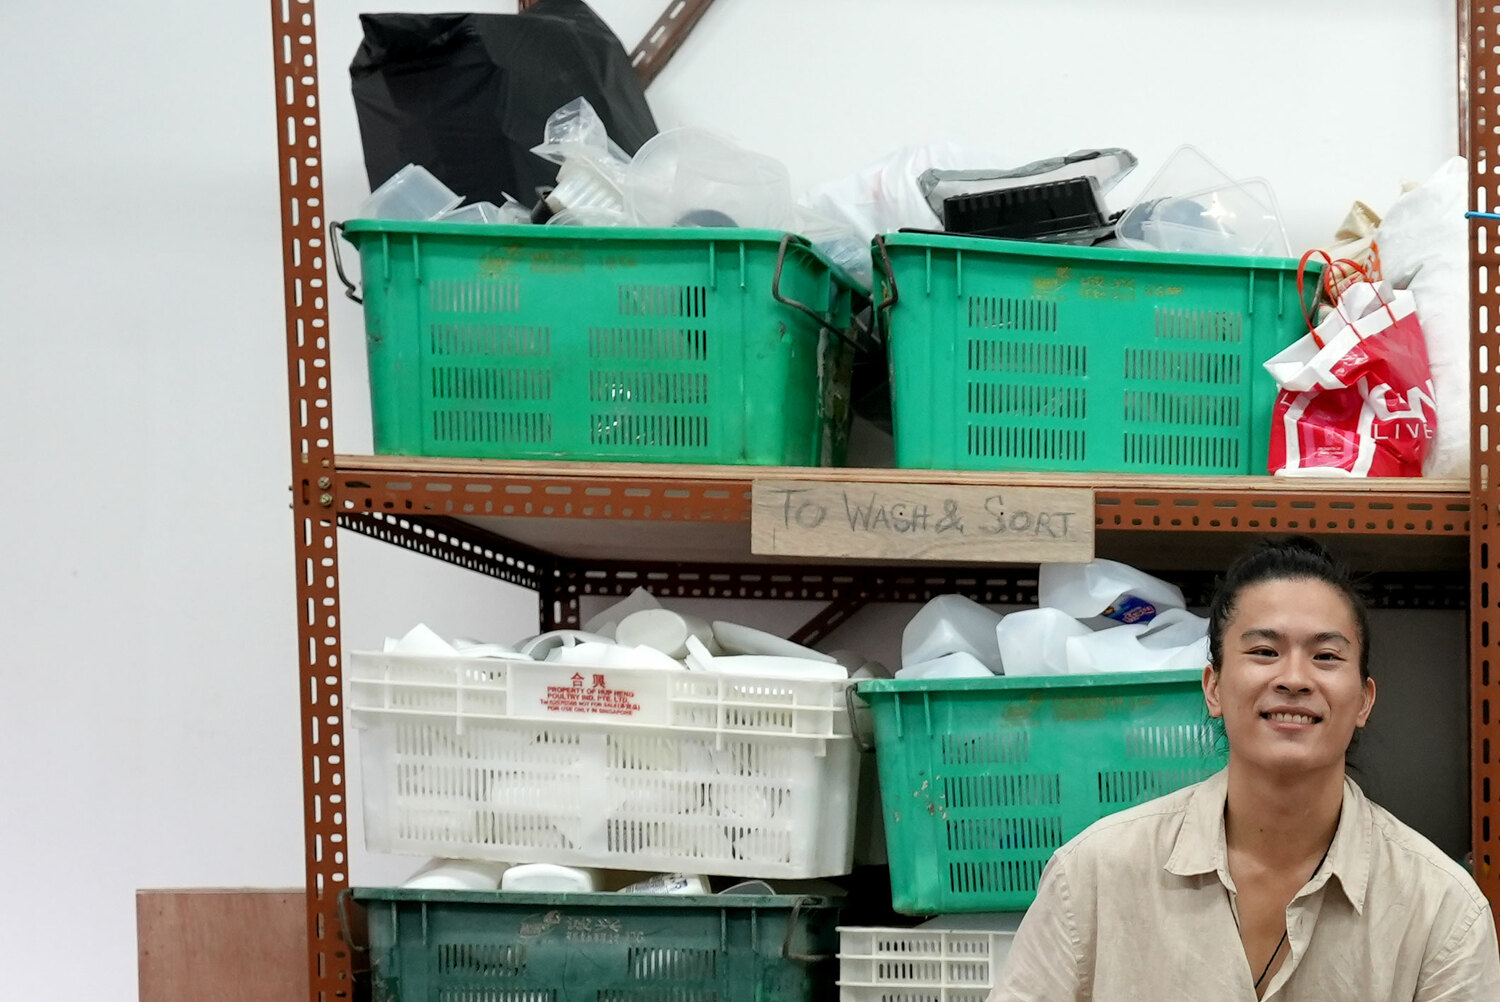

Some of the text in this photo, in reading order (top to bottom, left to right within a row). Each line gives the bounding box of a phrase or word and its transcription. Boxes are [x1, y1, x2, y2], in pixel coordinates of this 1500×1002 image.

[842, 490, 931, 533] WASH
[935, 498, 965, 535] &
[979, 495, 1076, 538] SORT
[547, 686, 584, 694] PROPERTY
[547, 693, 580, 701] POULTRY
